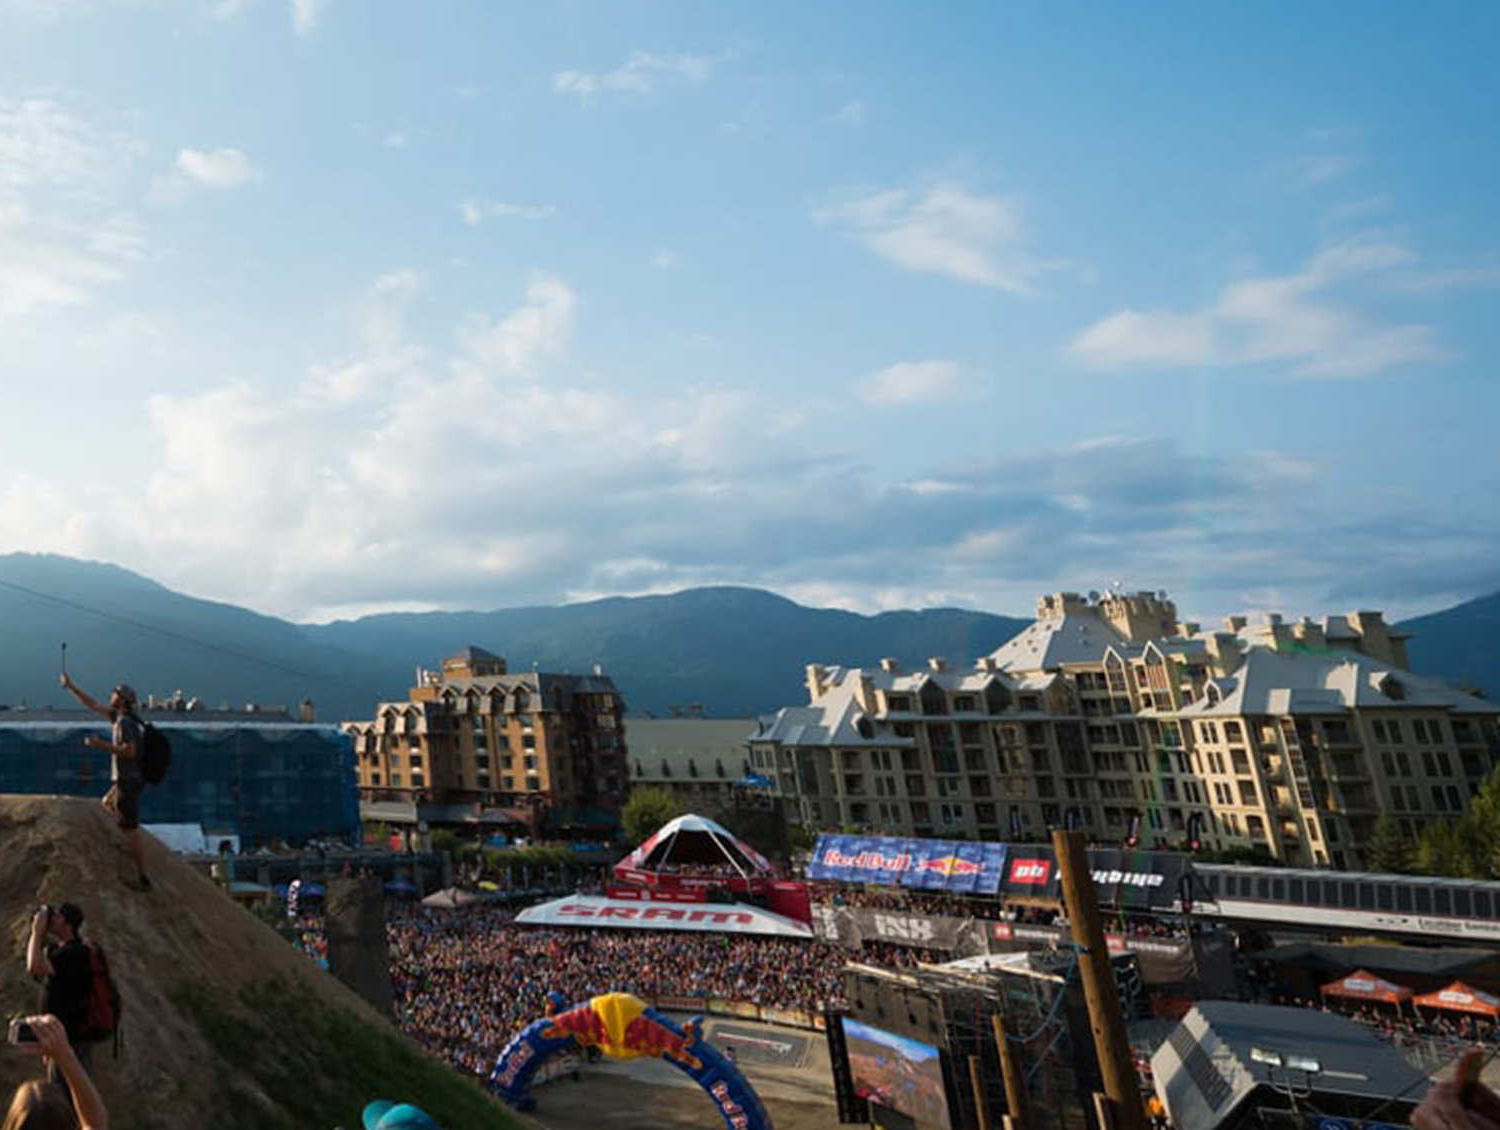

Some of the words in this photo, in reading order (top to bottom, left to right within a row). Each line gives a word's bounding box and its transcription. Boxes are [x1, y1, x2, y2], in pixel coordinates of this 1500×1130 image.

[823, 849, 867, 868] Red
[868, 851, 911, 872] Bull
[556, 903, 754, 924] SRAM
[711, 1079, 743, 1115] Red
